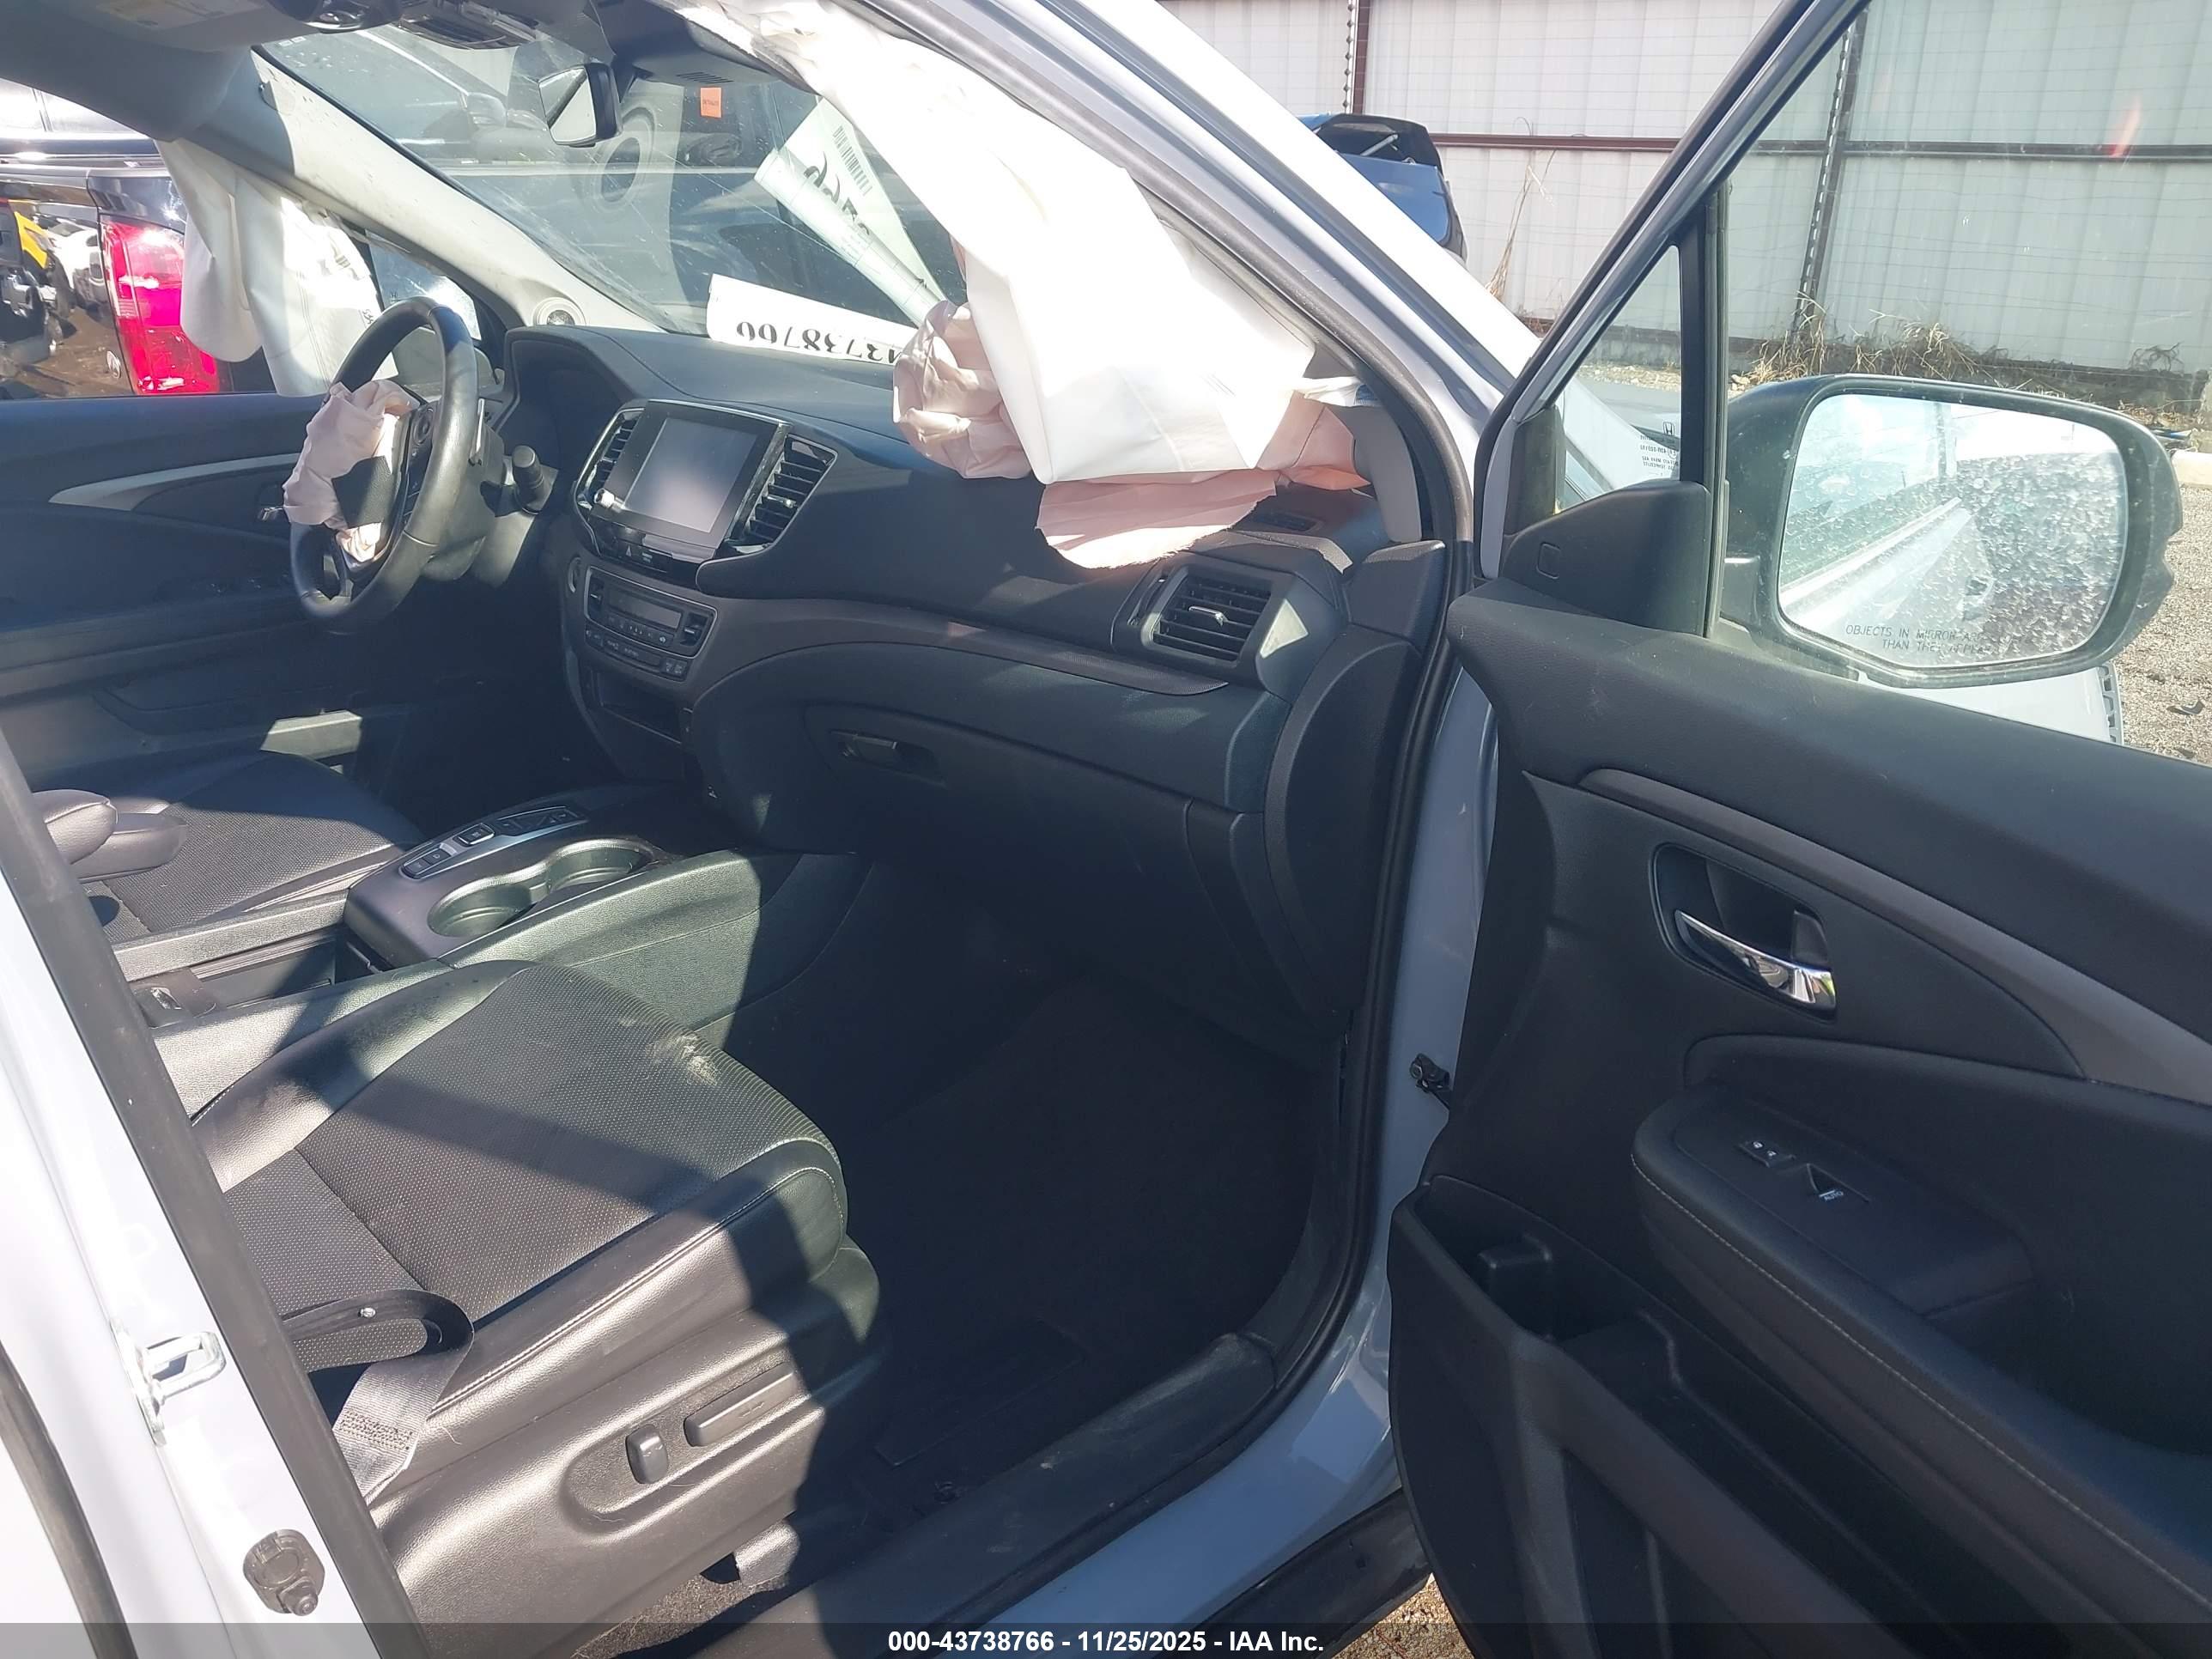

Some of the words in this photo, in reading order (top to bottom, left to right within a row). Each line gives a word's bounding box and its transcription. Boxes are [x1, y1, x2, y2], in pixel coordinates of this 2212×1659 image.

[1845, 625, 1892, 637] OBJECTS
[1899, 628, 1910, 638] IN
[1882, 639, 1909, 650] THAN
